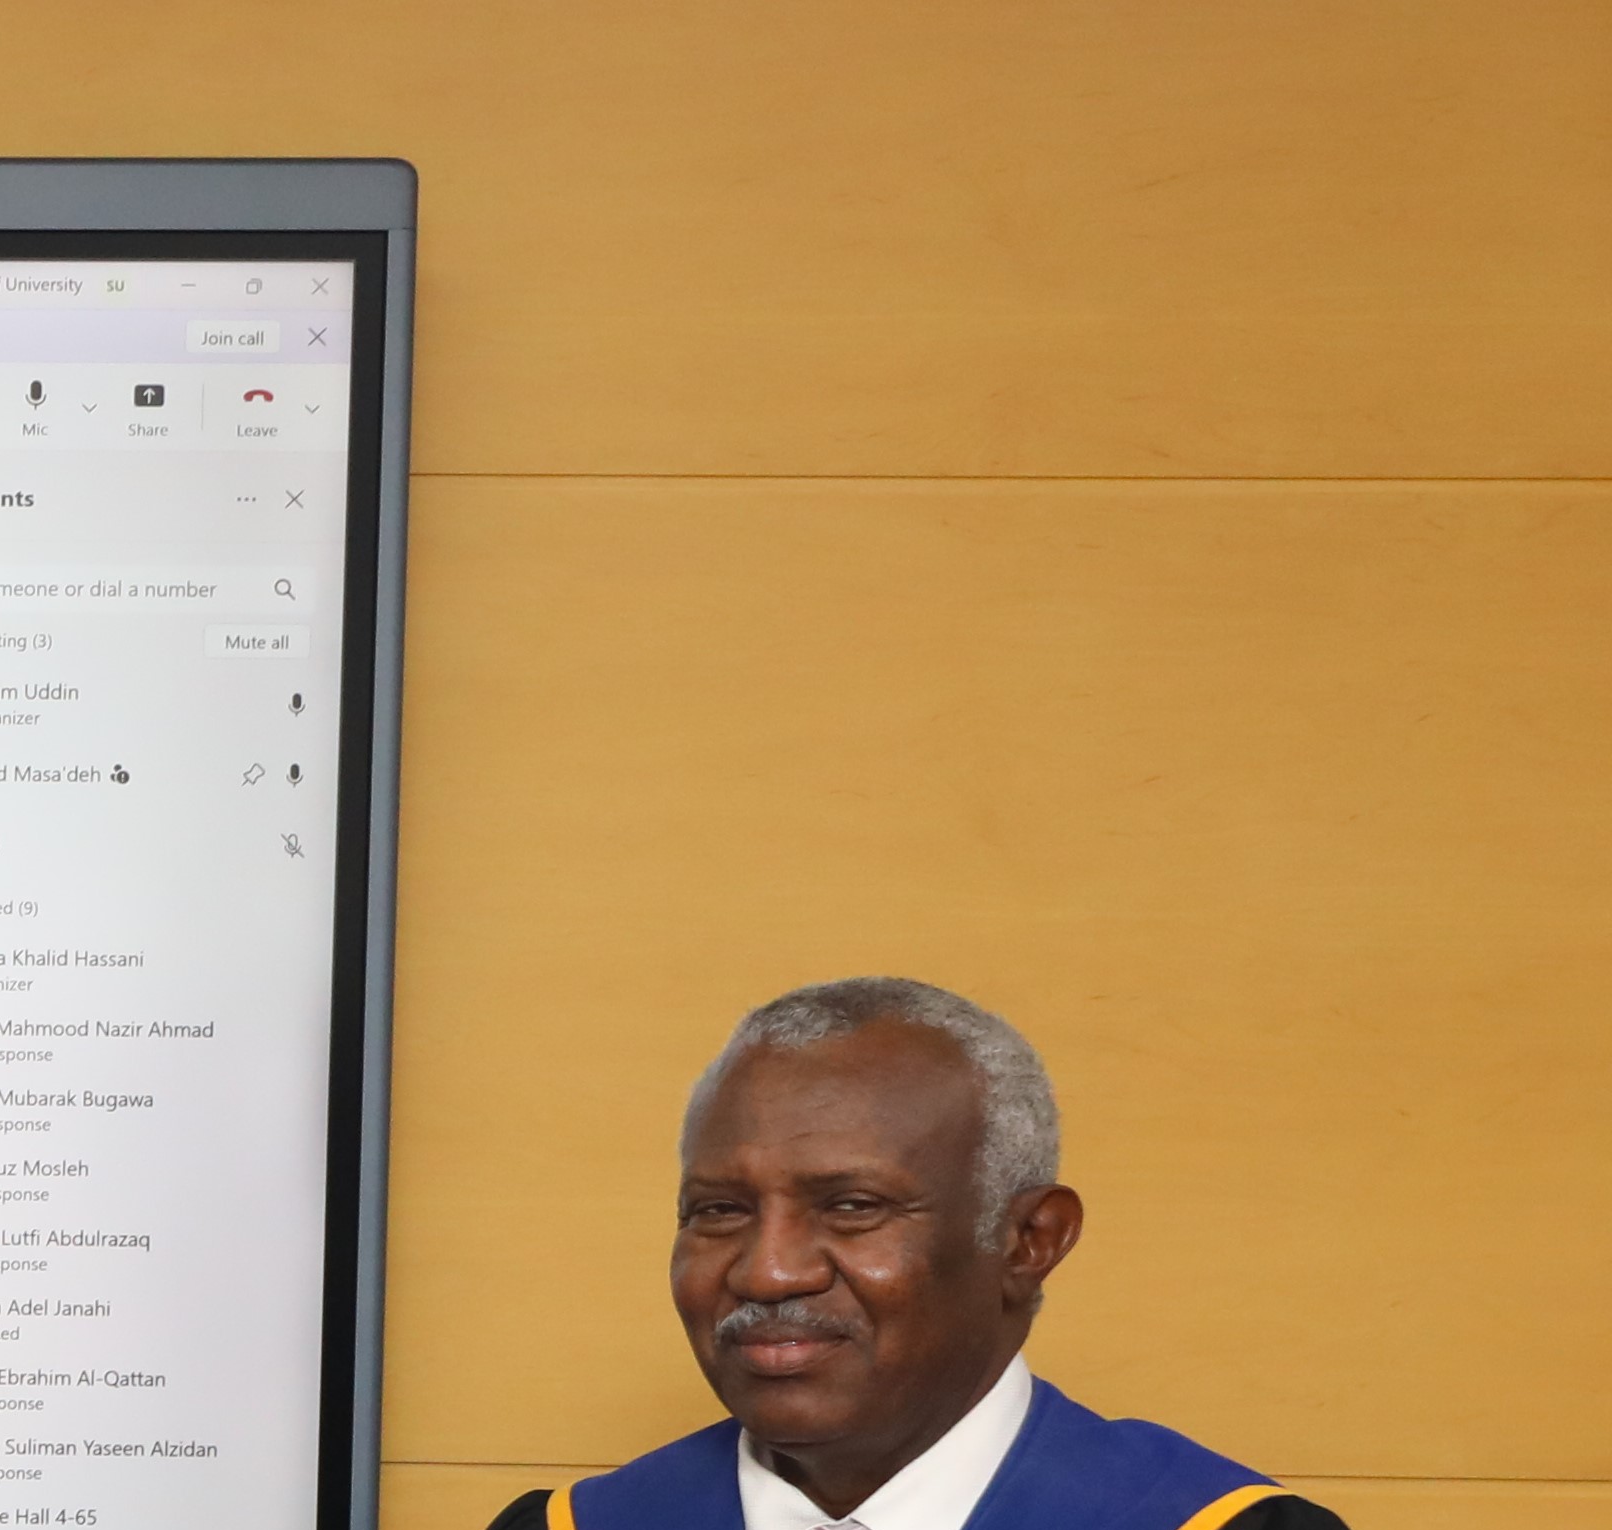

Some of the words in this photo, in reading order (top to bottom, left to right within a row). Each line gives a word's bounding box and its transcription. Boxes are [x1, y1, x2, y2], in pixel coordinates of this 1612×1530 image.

[5, 277, 83, 296] University
[107, 279, 125, 292] SU
[201, 331, 233, 346] Join
[239, 331, 264, 346] call
[22, 422, 48, 436] Mic
[128, 423, 168, 437] Share
[237, 424, 278, 437] Leave
[65, 585, 84, 598] or
[90, 580, 122, 598] dial
[128, 586, 138, 598] a
[145, 581, 217, 599] number
[32, 634, 53, 651] (3)
[225, 635, 265, 650] Mute
[271, 635, 289, 650] all
[25, 684, 79, 701] Uddin
[14, 766, 101, 783] Masa'deh
[18, 900, 39, 917] (9)
[12, 950, 68, 967] Khalid
[74, 951, 145, 968] Hassani
[96, 1021, 143, 1038] Nazir
[148, 1022, 214, 1039] Ahmad
[83, 1092, 154, 1111] Bugawa
[23, 1160, 89, 1177] Mosleh
[1, 1230, 40, 1247] Lutfi
[46, 1230, 151, 1251] Abdulrazaq
[7, 1299, 49, 1316] Adel
[55, 1300, 111, 1317] Janahi
[77, 1370, 166, 1390] Al-Qattan
[5, 1439, 77, 1456] Suliman
[83, 1440, 145, 1457] Yaseen
[151, 1440, 218, 1458] Alzidan
[15, 1508, 50, 1525] Hall
[55, 1509, 97, 1526] 4-65
